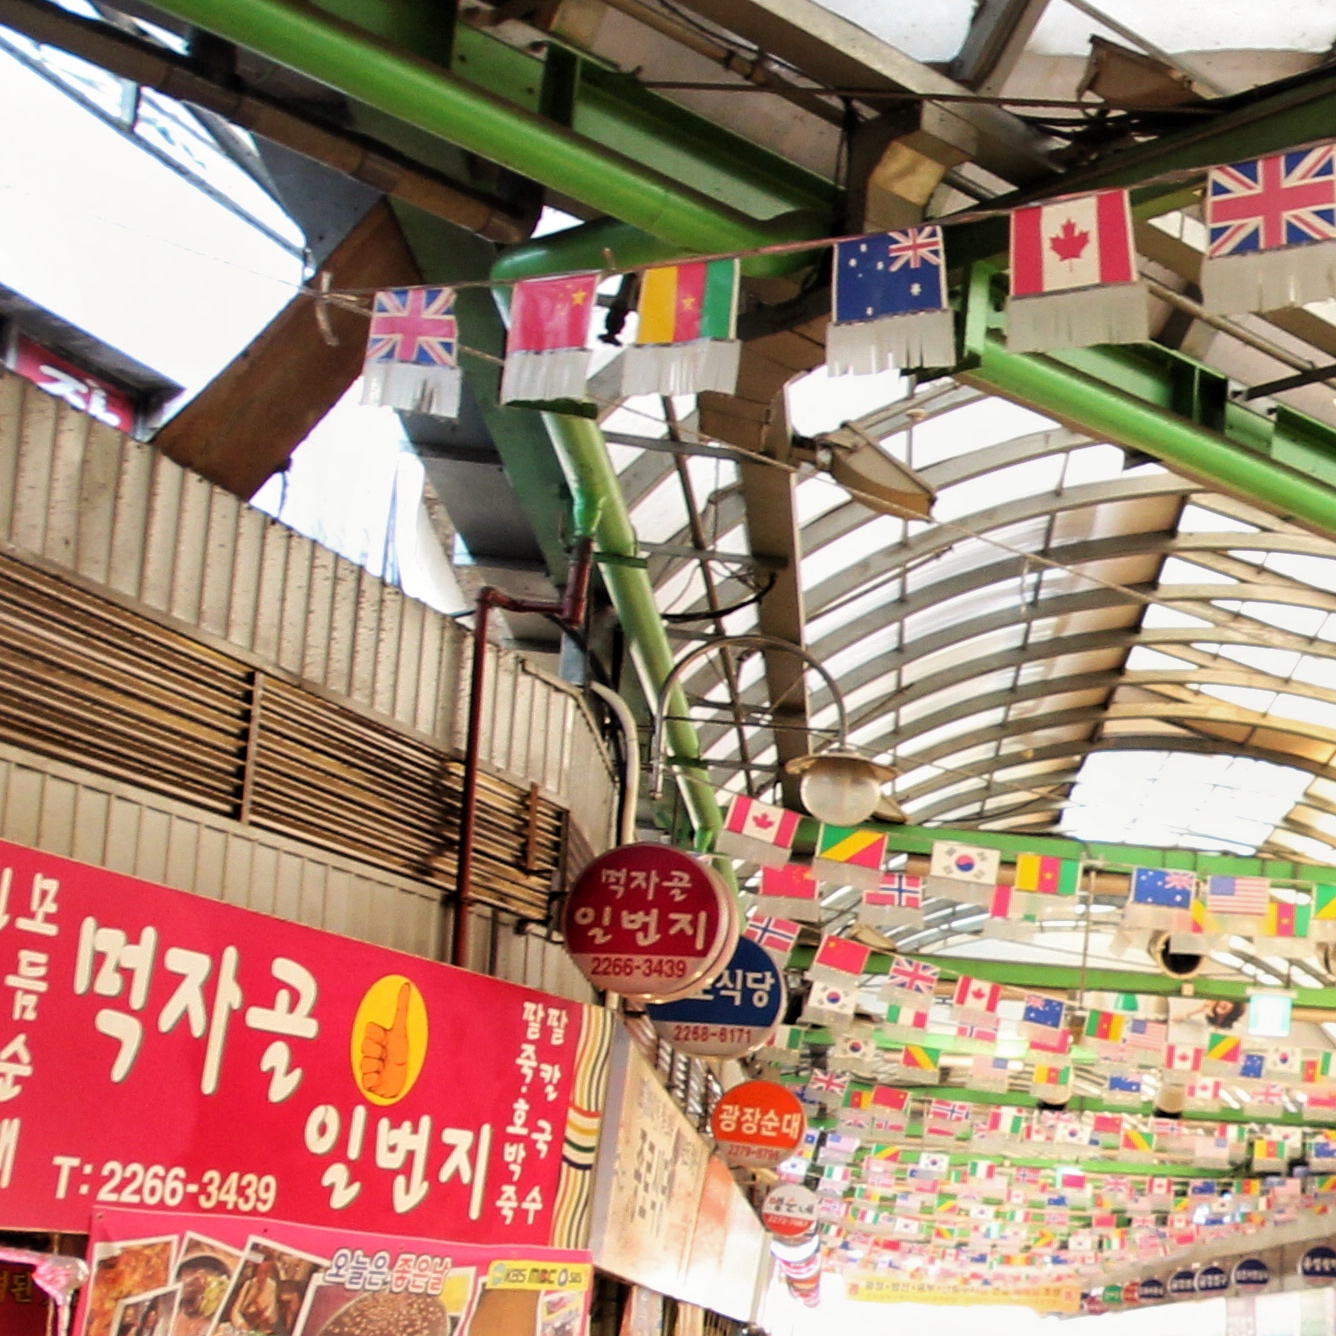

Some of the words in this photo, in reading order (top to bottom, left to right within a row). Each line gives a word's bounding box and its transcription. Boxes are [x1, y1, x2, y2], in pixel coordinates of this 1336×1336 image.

[601, 868, 692, 901] 먹자골
[575, 907, 707, 950] 일번지
[591, 957, 686, 979] 2266-3439
[688, 969, 775, 1008] 식당
[74, 916, 318, 1103] 먹자골
[719, 1104, 801, 1139] 광장순대
[304, 1104, 492, 1221] 일번지
[325, 1249, 390, 1291] 오늘은
